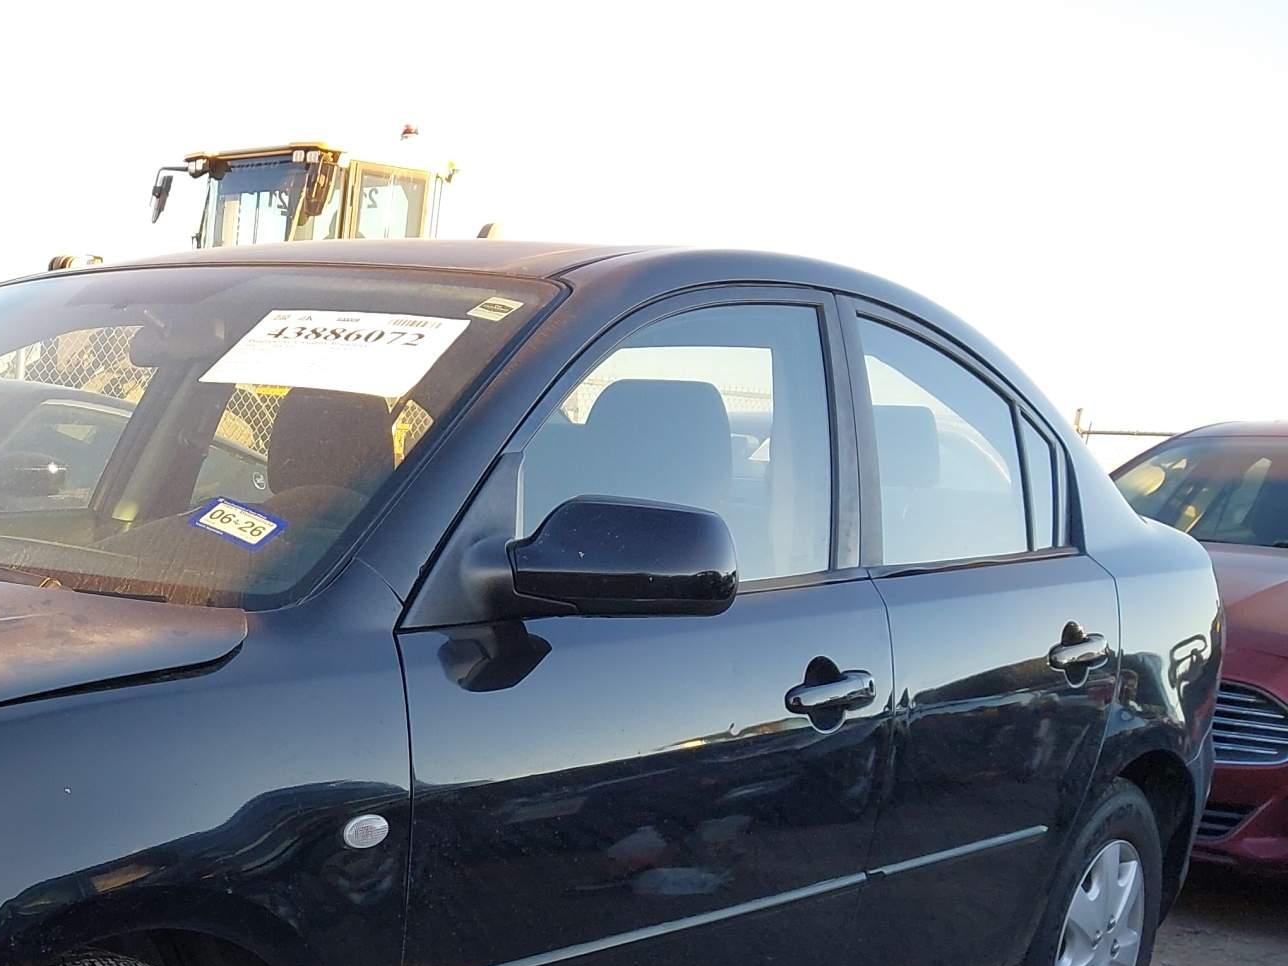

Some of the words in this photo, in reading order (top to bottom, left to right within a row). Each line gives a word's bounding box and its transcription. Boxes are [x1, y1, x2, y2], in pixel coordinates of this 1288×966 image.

[266, 325, 425, 346] 43886072
[209, 509, 236, 524] 06
[238, 520, 266, 537] 26
